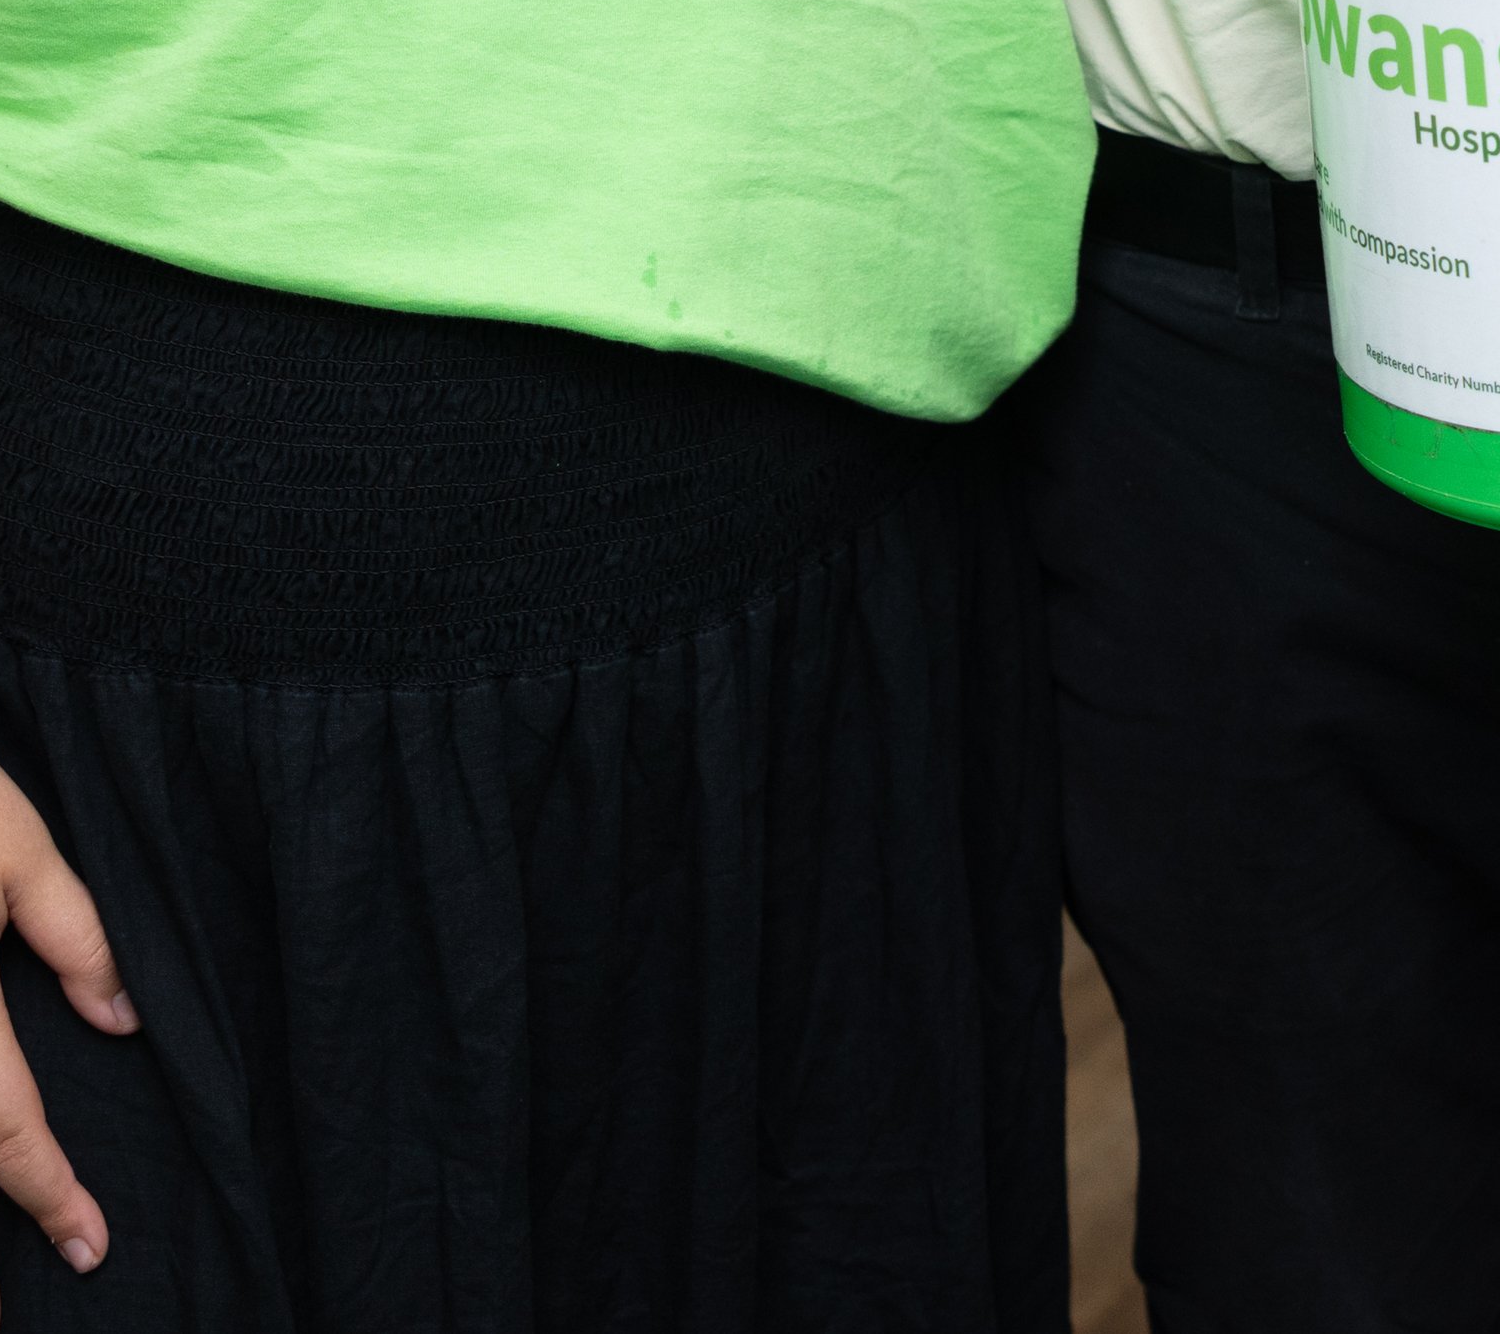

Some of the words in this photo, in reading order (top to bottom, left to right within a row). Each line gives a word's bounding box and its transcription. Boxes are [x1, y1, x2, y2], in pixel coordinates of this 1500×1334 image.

[1323, 198, 1348, 238] with
[1350, 224, 1470, 278] compassion
[1365, 343, 1414, 376] Registered
[1416, 365, 1459, 388] Charity
